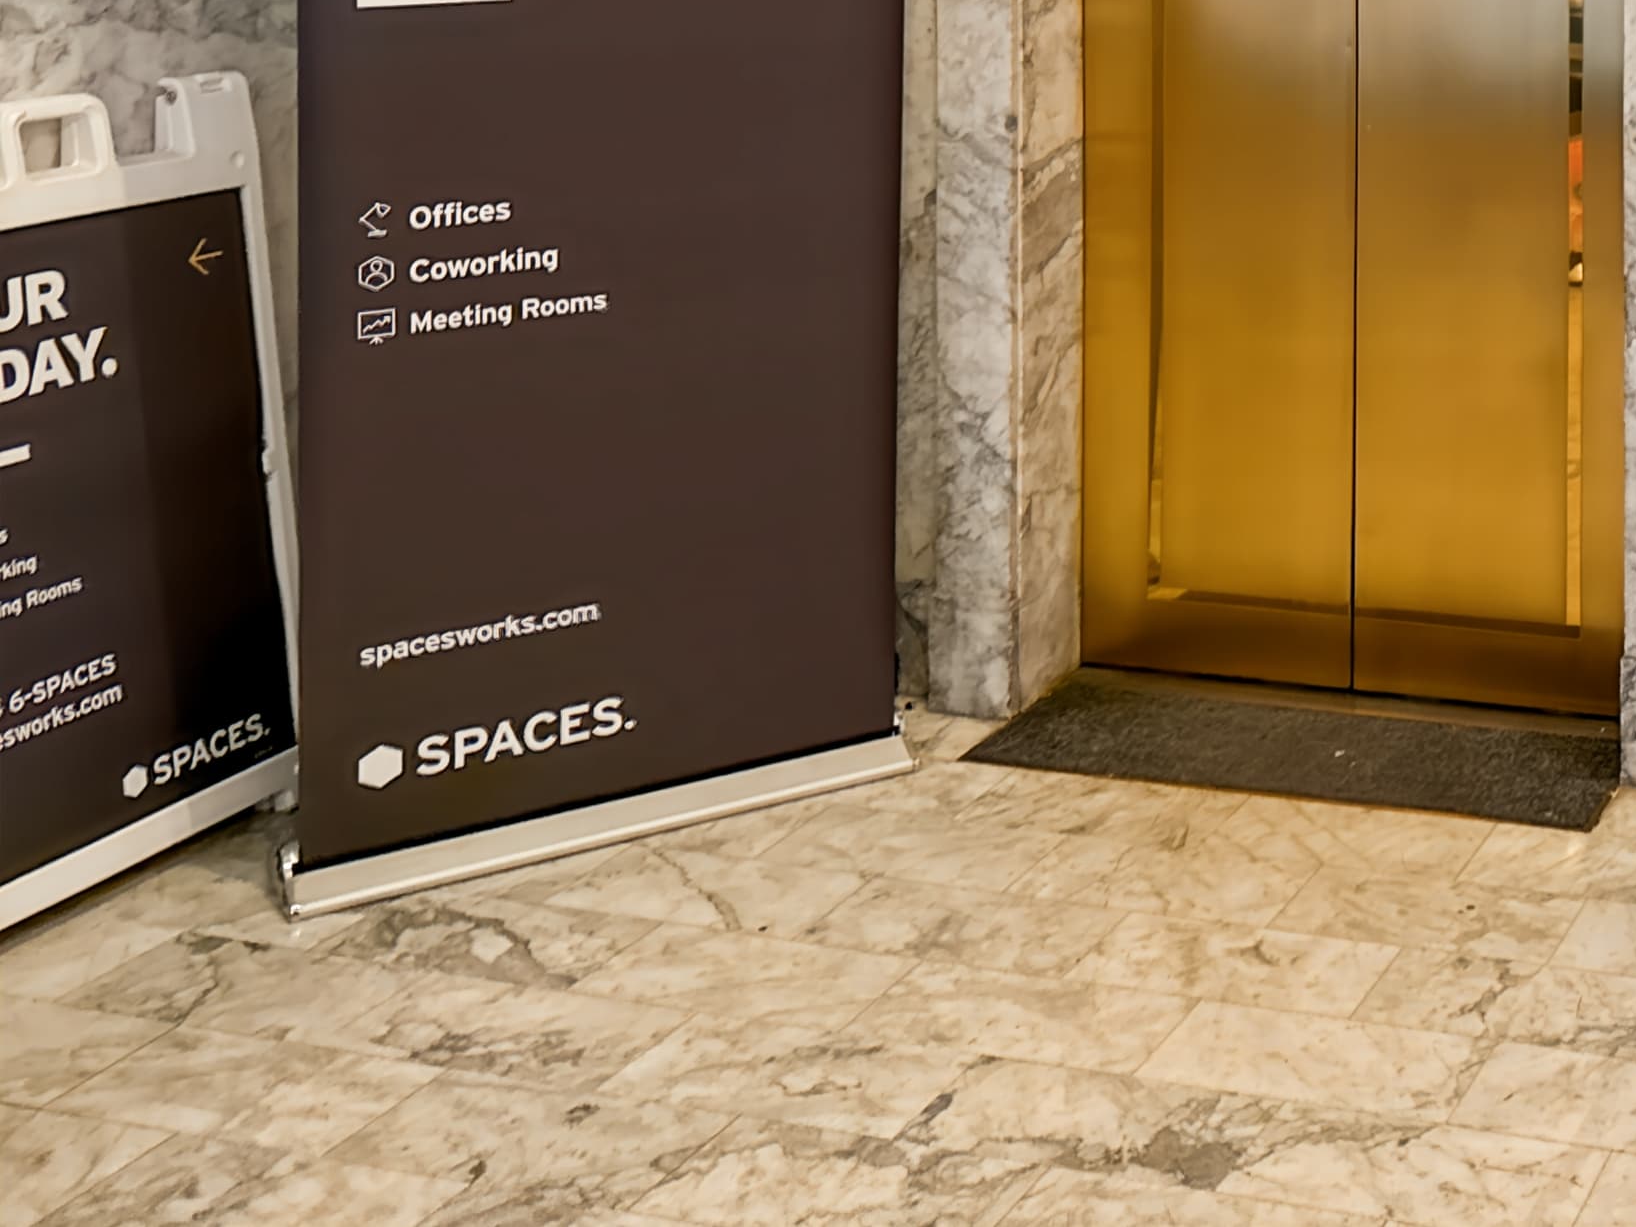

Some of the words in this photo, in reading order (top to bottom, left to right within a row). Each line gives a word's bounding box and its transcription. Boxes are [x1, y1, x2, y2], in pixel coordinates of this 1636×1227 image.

[409, 201, 512, 230] Offices
[409, 247, 559, 283] Coworking
[410, 304, 512, 334] Meeting
[522, 293, 608, 319] Rooms
[26, 577, 82, 609] Rooms
[360, 603, 600, 668] spacesworks.com
[9, 653, 117, 713] 6-SPACES
[153, 713, 271, 785] SPACES.
[416, 696, 637, 776] SPACES.
